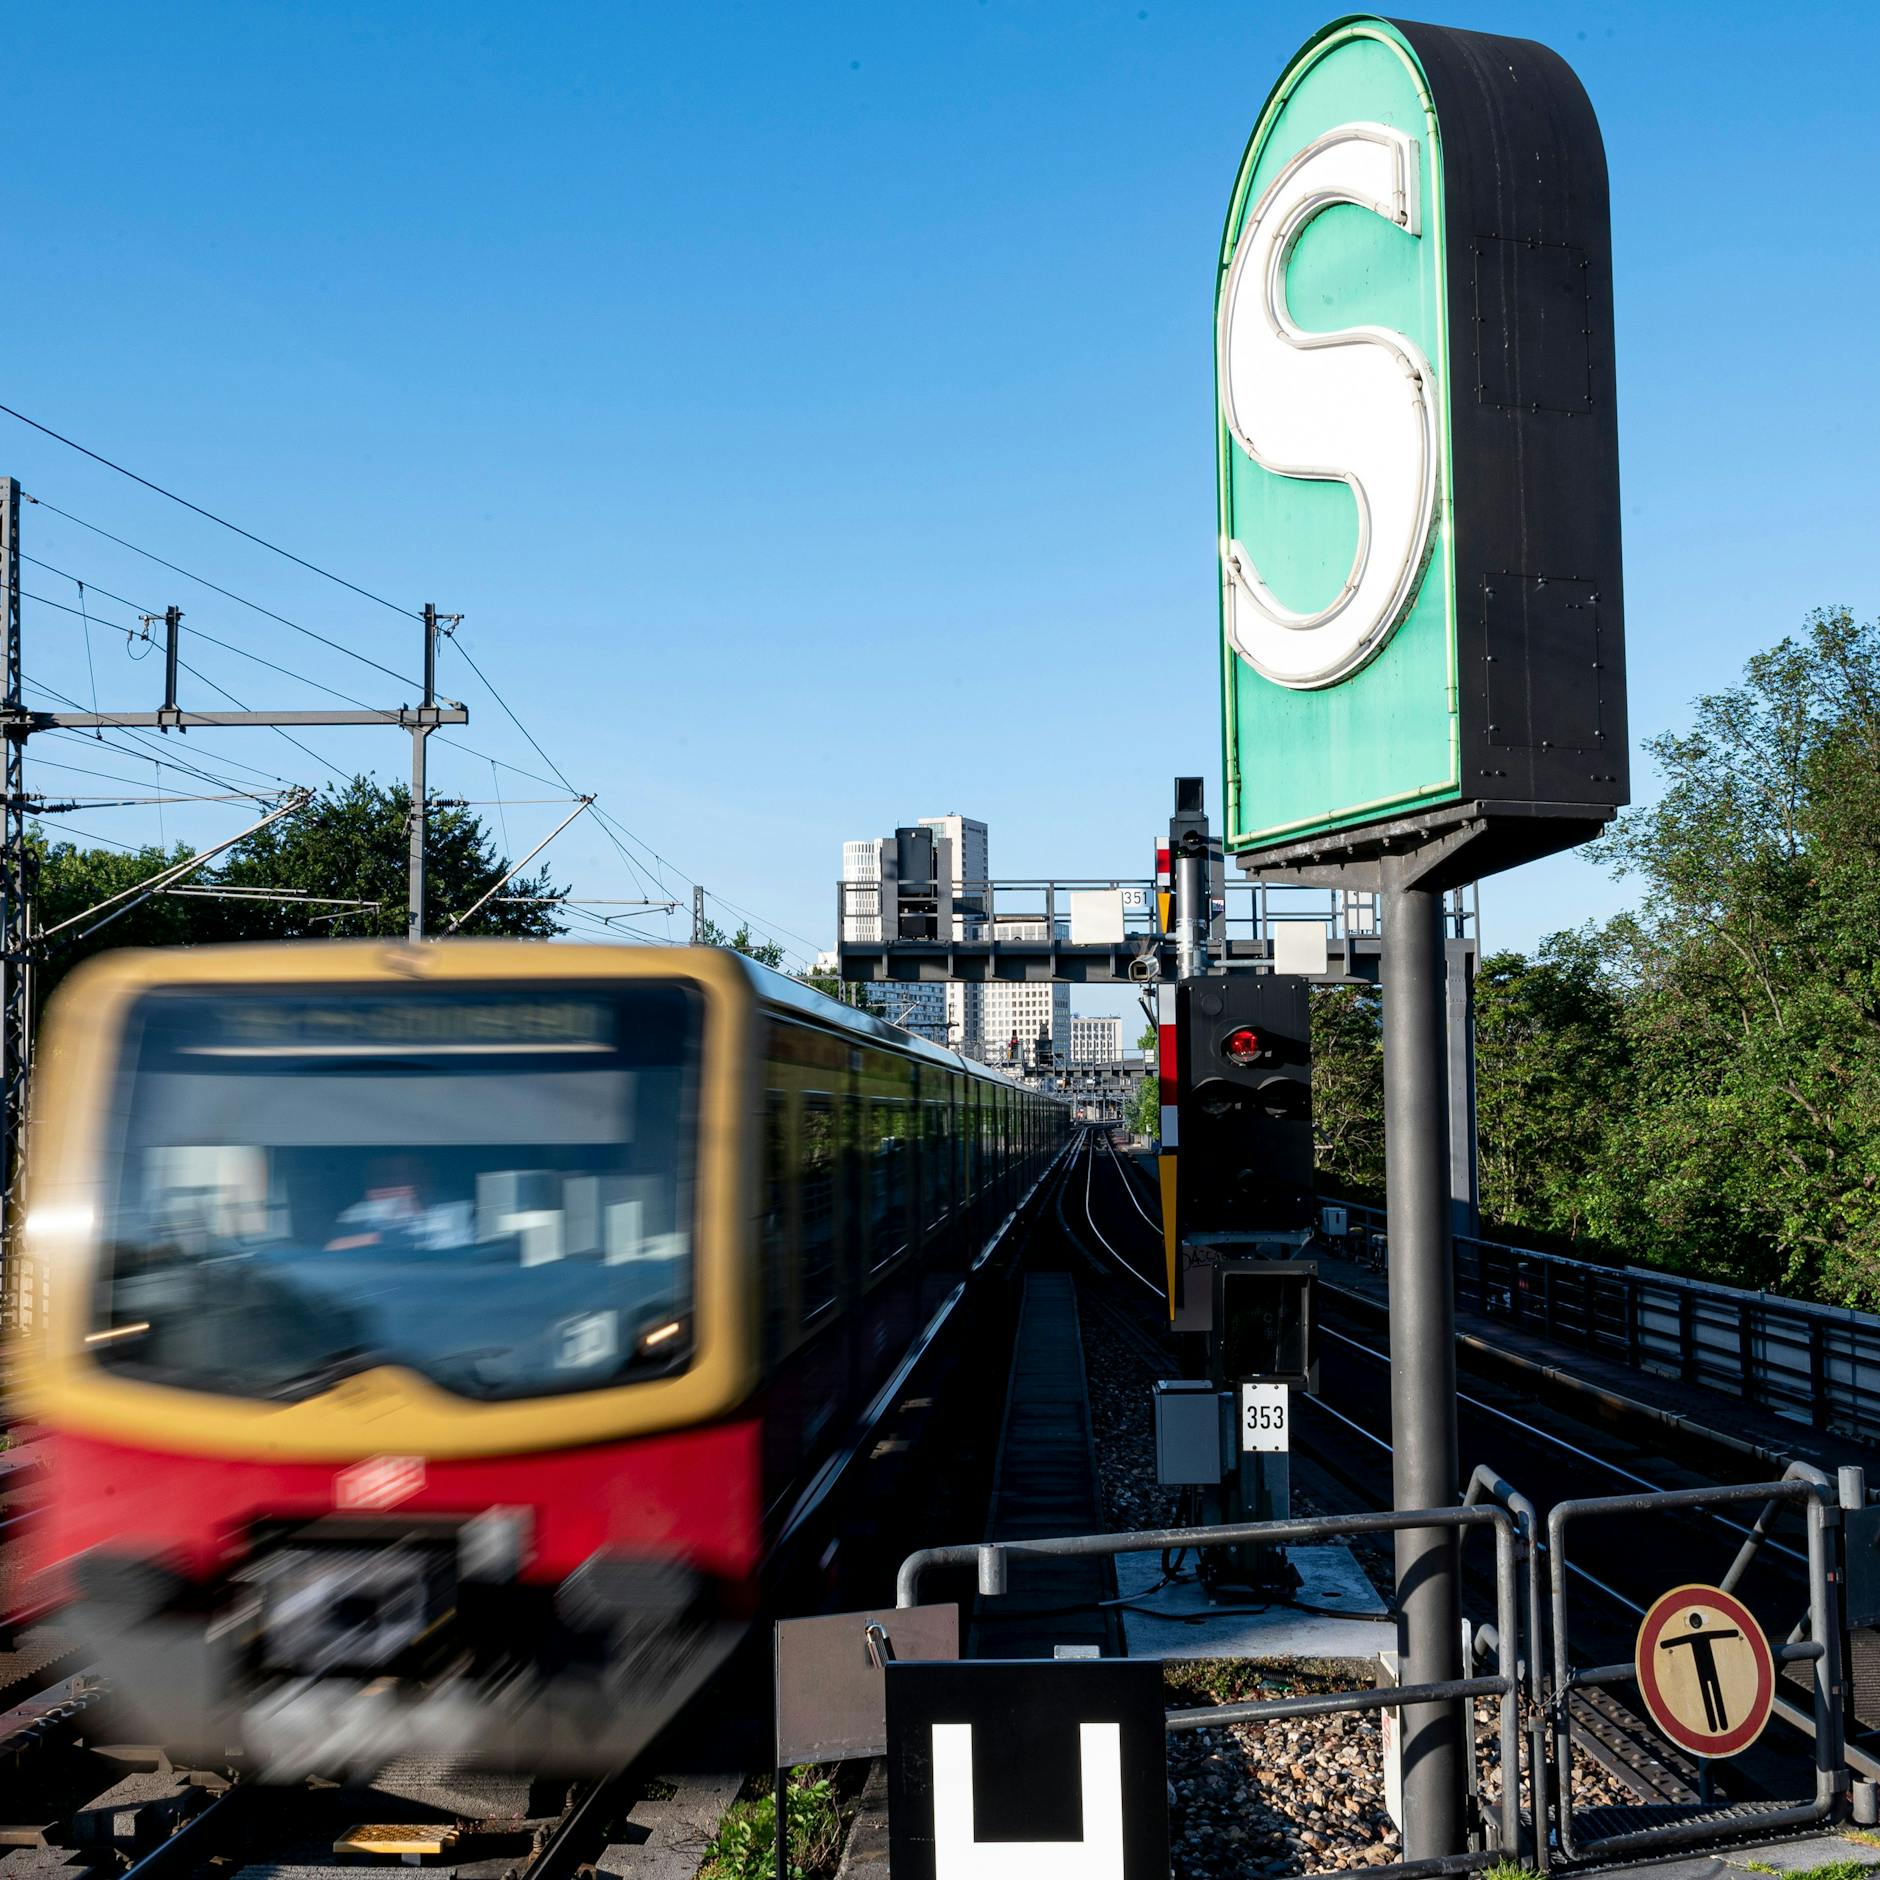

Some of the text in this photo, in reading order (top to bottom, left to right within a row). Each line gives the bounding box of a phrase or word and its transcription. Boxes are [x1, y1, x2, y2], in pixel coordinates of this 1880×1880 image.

[1217, 121, 1438, 690] S
[1124, 891, 1148, 905] 351
[1247, 1405, 1284, 1429] 353
